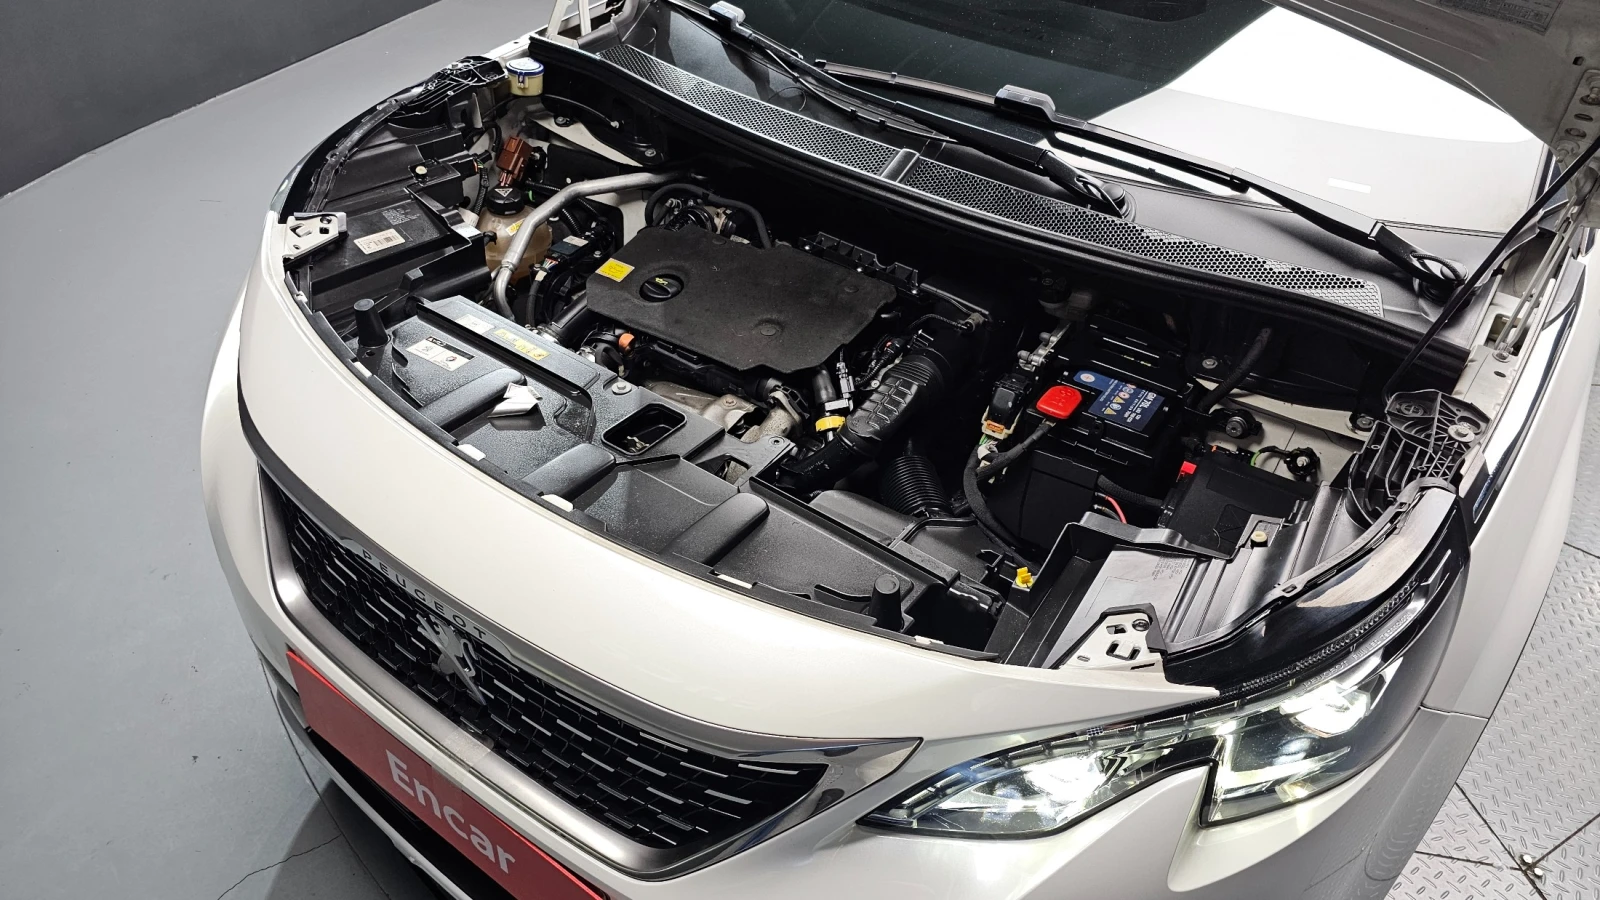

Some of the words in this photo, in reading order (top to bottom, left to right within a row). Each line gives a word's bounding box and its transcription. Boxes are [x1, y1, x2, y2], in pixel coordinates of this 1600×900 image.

[362, 549, 486, 639] PEUGEOT
[1302, 660, 1348, 688] PEUGEOT
[1352, 648, 1367, 660] FULL
[386, 749, 516, 874] Encar
